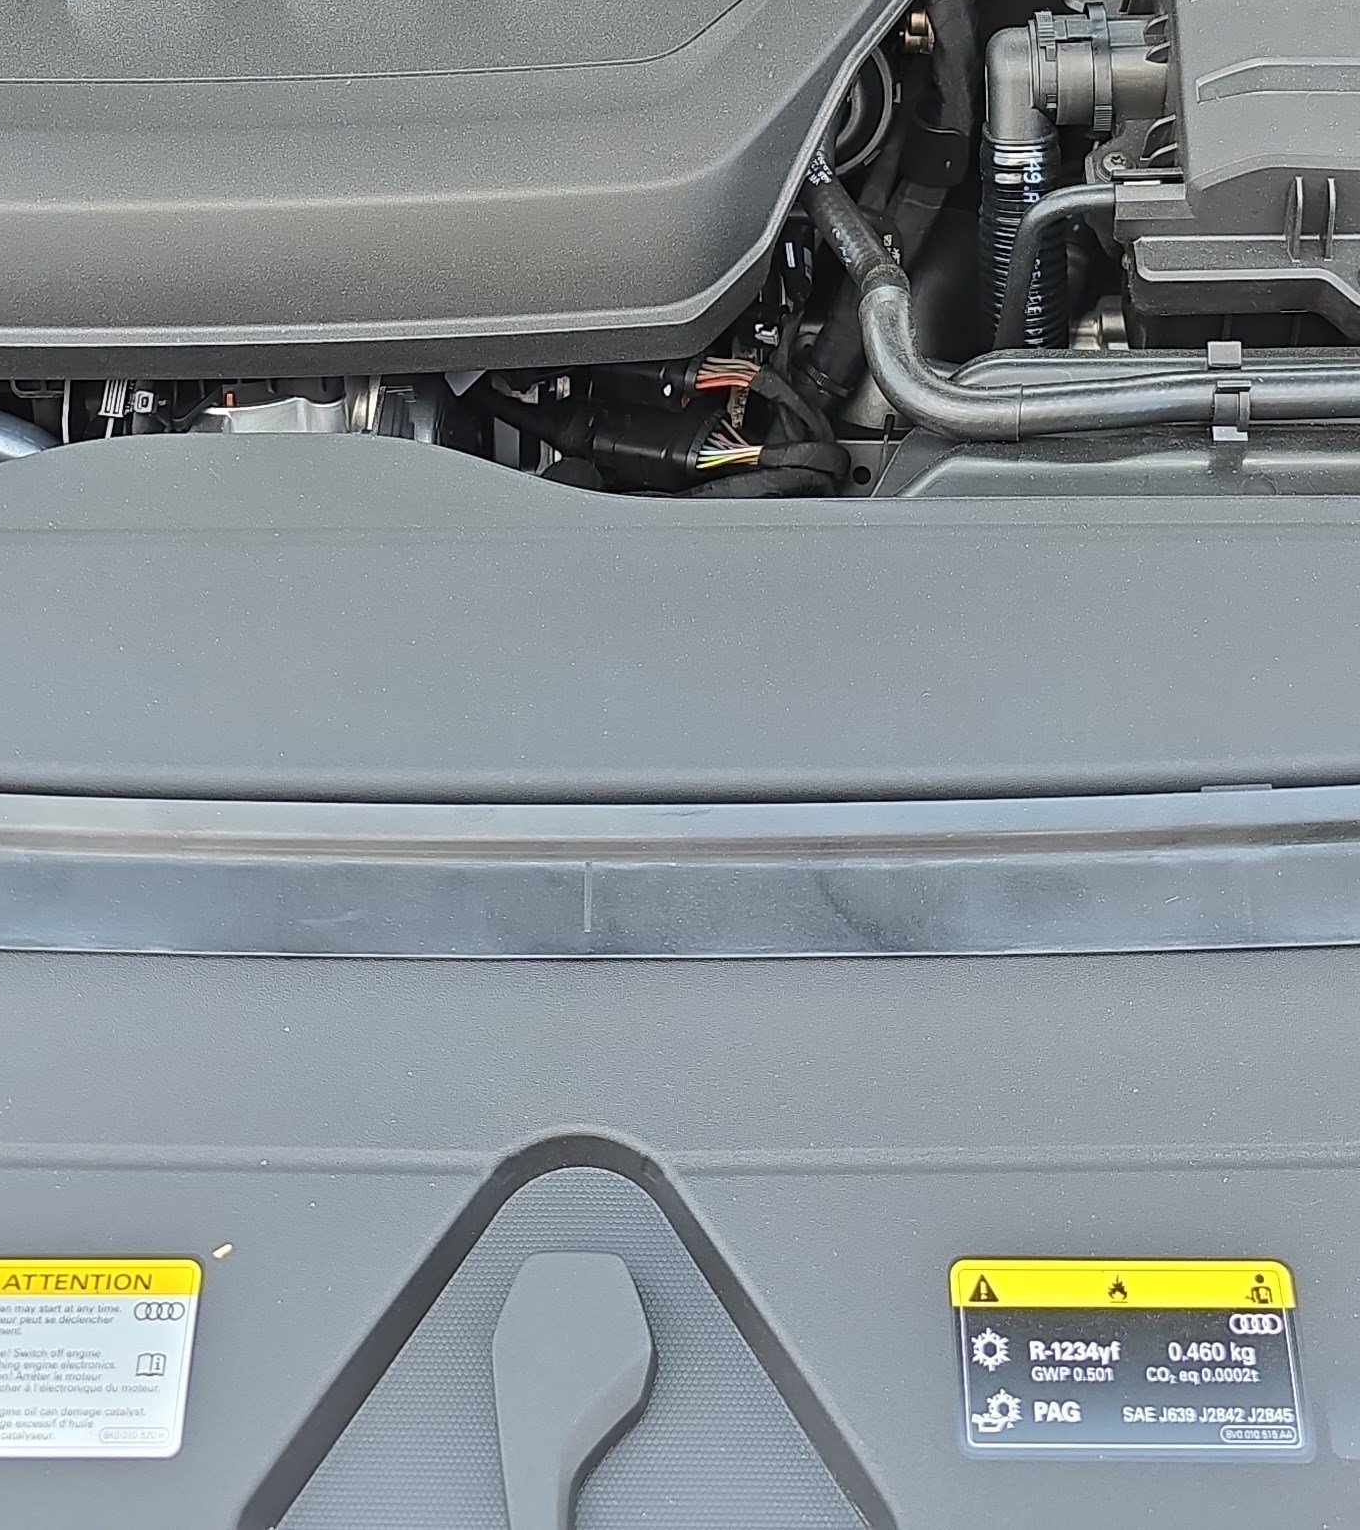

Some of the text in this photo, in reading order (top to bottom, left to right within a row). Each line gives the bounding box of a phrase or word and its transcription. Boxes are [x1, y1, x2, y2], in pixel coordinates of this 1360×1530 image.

[1, 1271, 153, 1291] ATTENTION
[15, 1304, 35, 1315] may
[39, 1304, 61, 1313] start
[65, 1304, 74, 1313] at
[77, 1304, 93, 1315] any
[98, 1304, 122, 1313] time.
[19, 1315, 42, 1326] peut
[45, 1316, 56, 1324] se
[14, 1348, 48, 1358] Switch
[51, 1348, 65, 1359] off
[67, 1349, 101, 1360] engine
[1029, 1341, 1256, 1366] R-1234yf 0.460 kg
[23, 1361, 57, 1372] engine
[65, 1373, 103, 1381] moteur
[1031, 1368, 1071, 1382] GWP
[1073, 1368, 1114, 1382] 0.501
[1180, 1370, 1199, 1385] eq
[106, 1384, 118, 1393] du
[24, 1406, 36, 1417] oil
[39, 1408, 57, 1417] can
[61, 1407, 102, 1419] damage
[1034, 1402, 1294, 1423] PAG SAE J639 J2842 J2845
